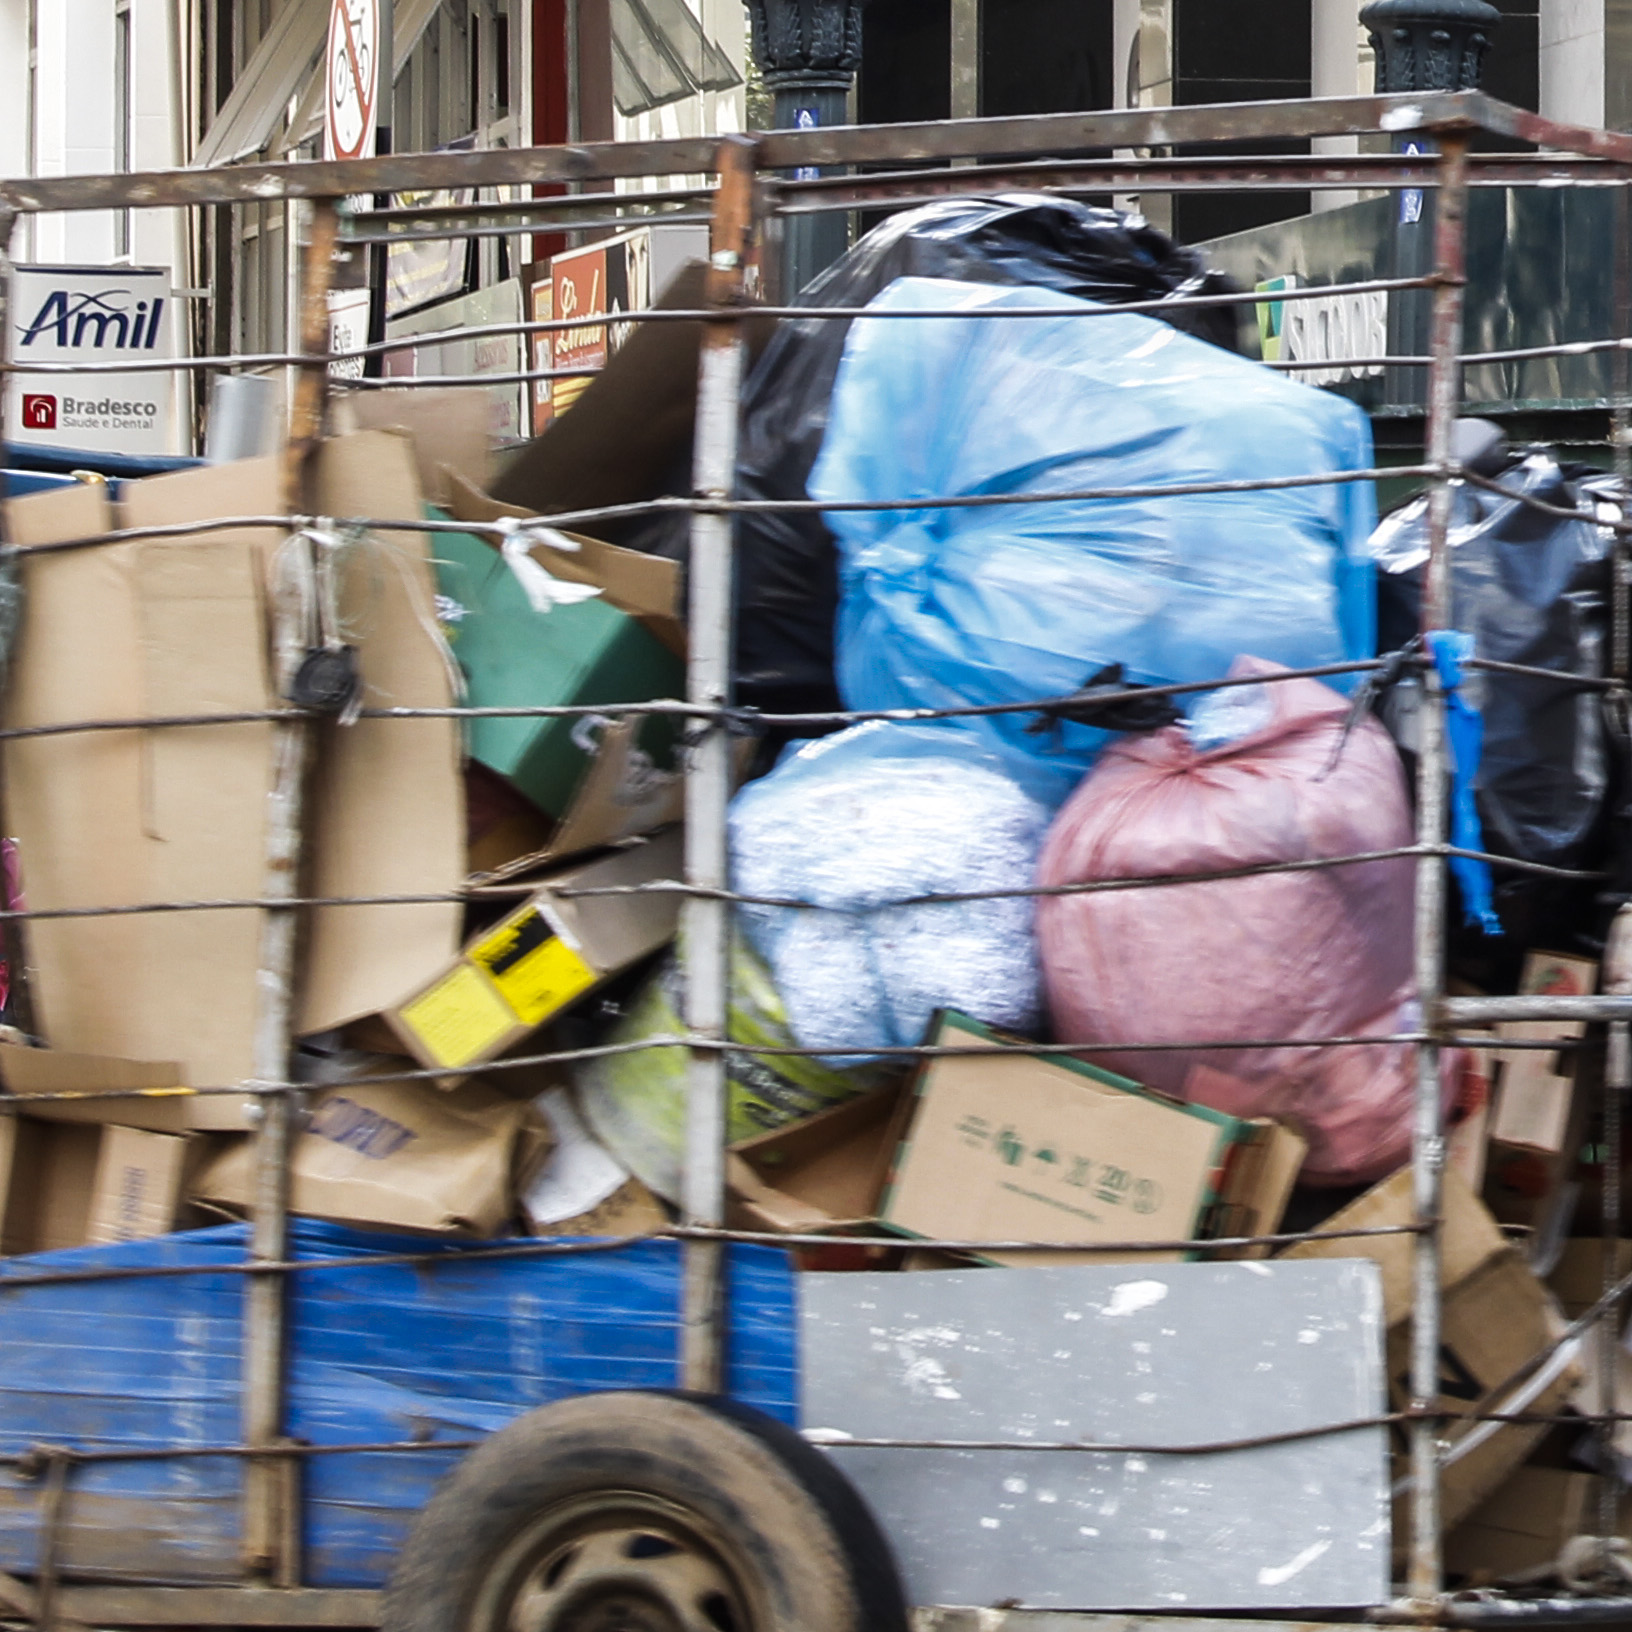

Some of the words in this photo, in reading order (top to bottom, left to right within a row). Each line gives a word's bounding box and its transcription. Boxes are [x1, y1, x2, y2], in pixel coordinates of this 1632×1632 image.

[20, 290, 164, 349] Amil
[62, 397, 157, 417] Bradesco
[112, 417, 153, 429] Dental
